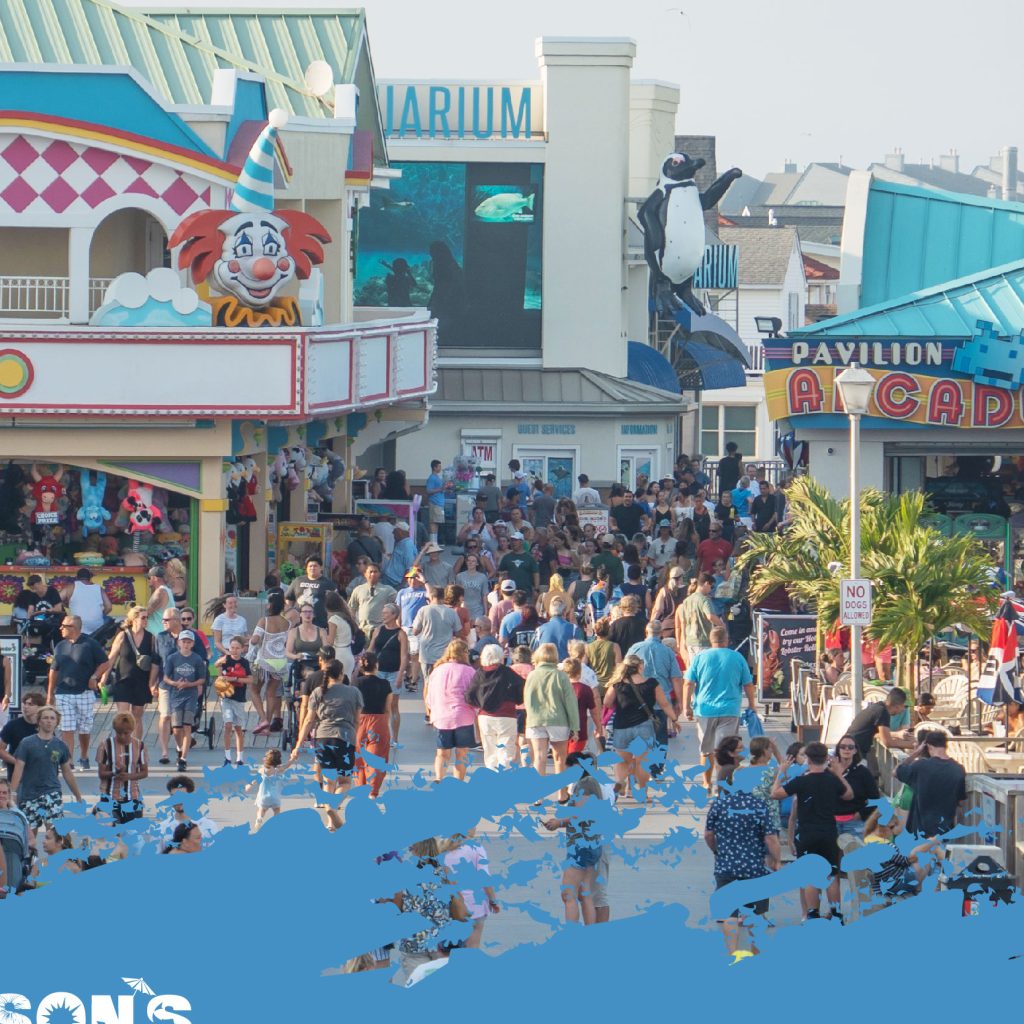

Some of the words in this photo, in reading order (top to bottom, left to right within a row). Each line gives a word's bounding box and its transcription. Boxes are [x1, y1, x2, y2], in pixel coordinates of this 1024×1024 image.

[791, 341, 943, 366] PAVILION
[786, 367, 1024, 429] ACAD
[517, 424, 539, 435] GUEST
[541, 424, 576, 435] SERVICES
[621, 424, 658, 435] INFORMATION
[471, 445, 493, 461] ATM
[846, 585, 865, 598] NO
[845, 601, 867, 609] DOGS
[843, 612, 869, 620] ALLOWED
[780, 628, 798, 636] Come
[780, 647, 802, 656] Lobster
